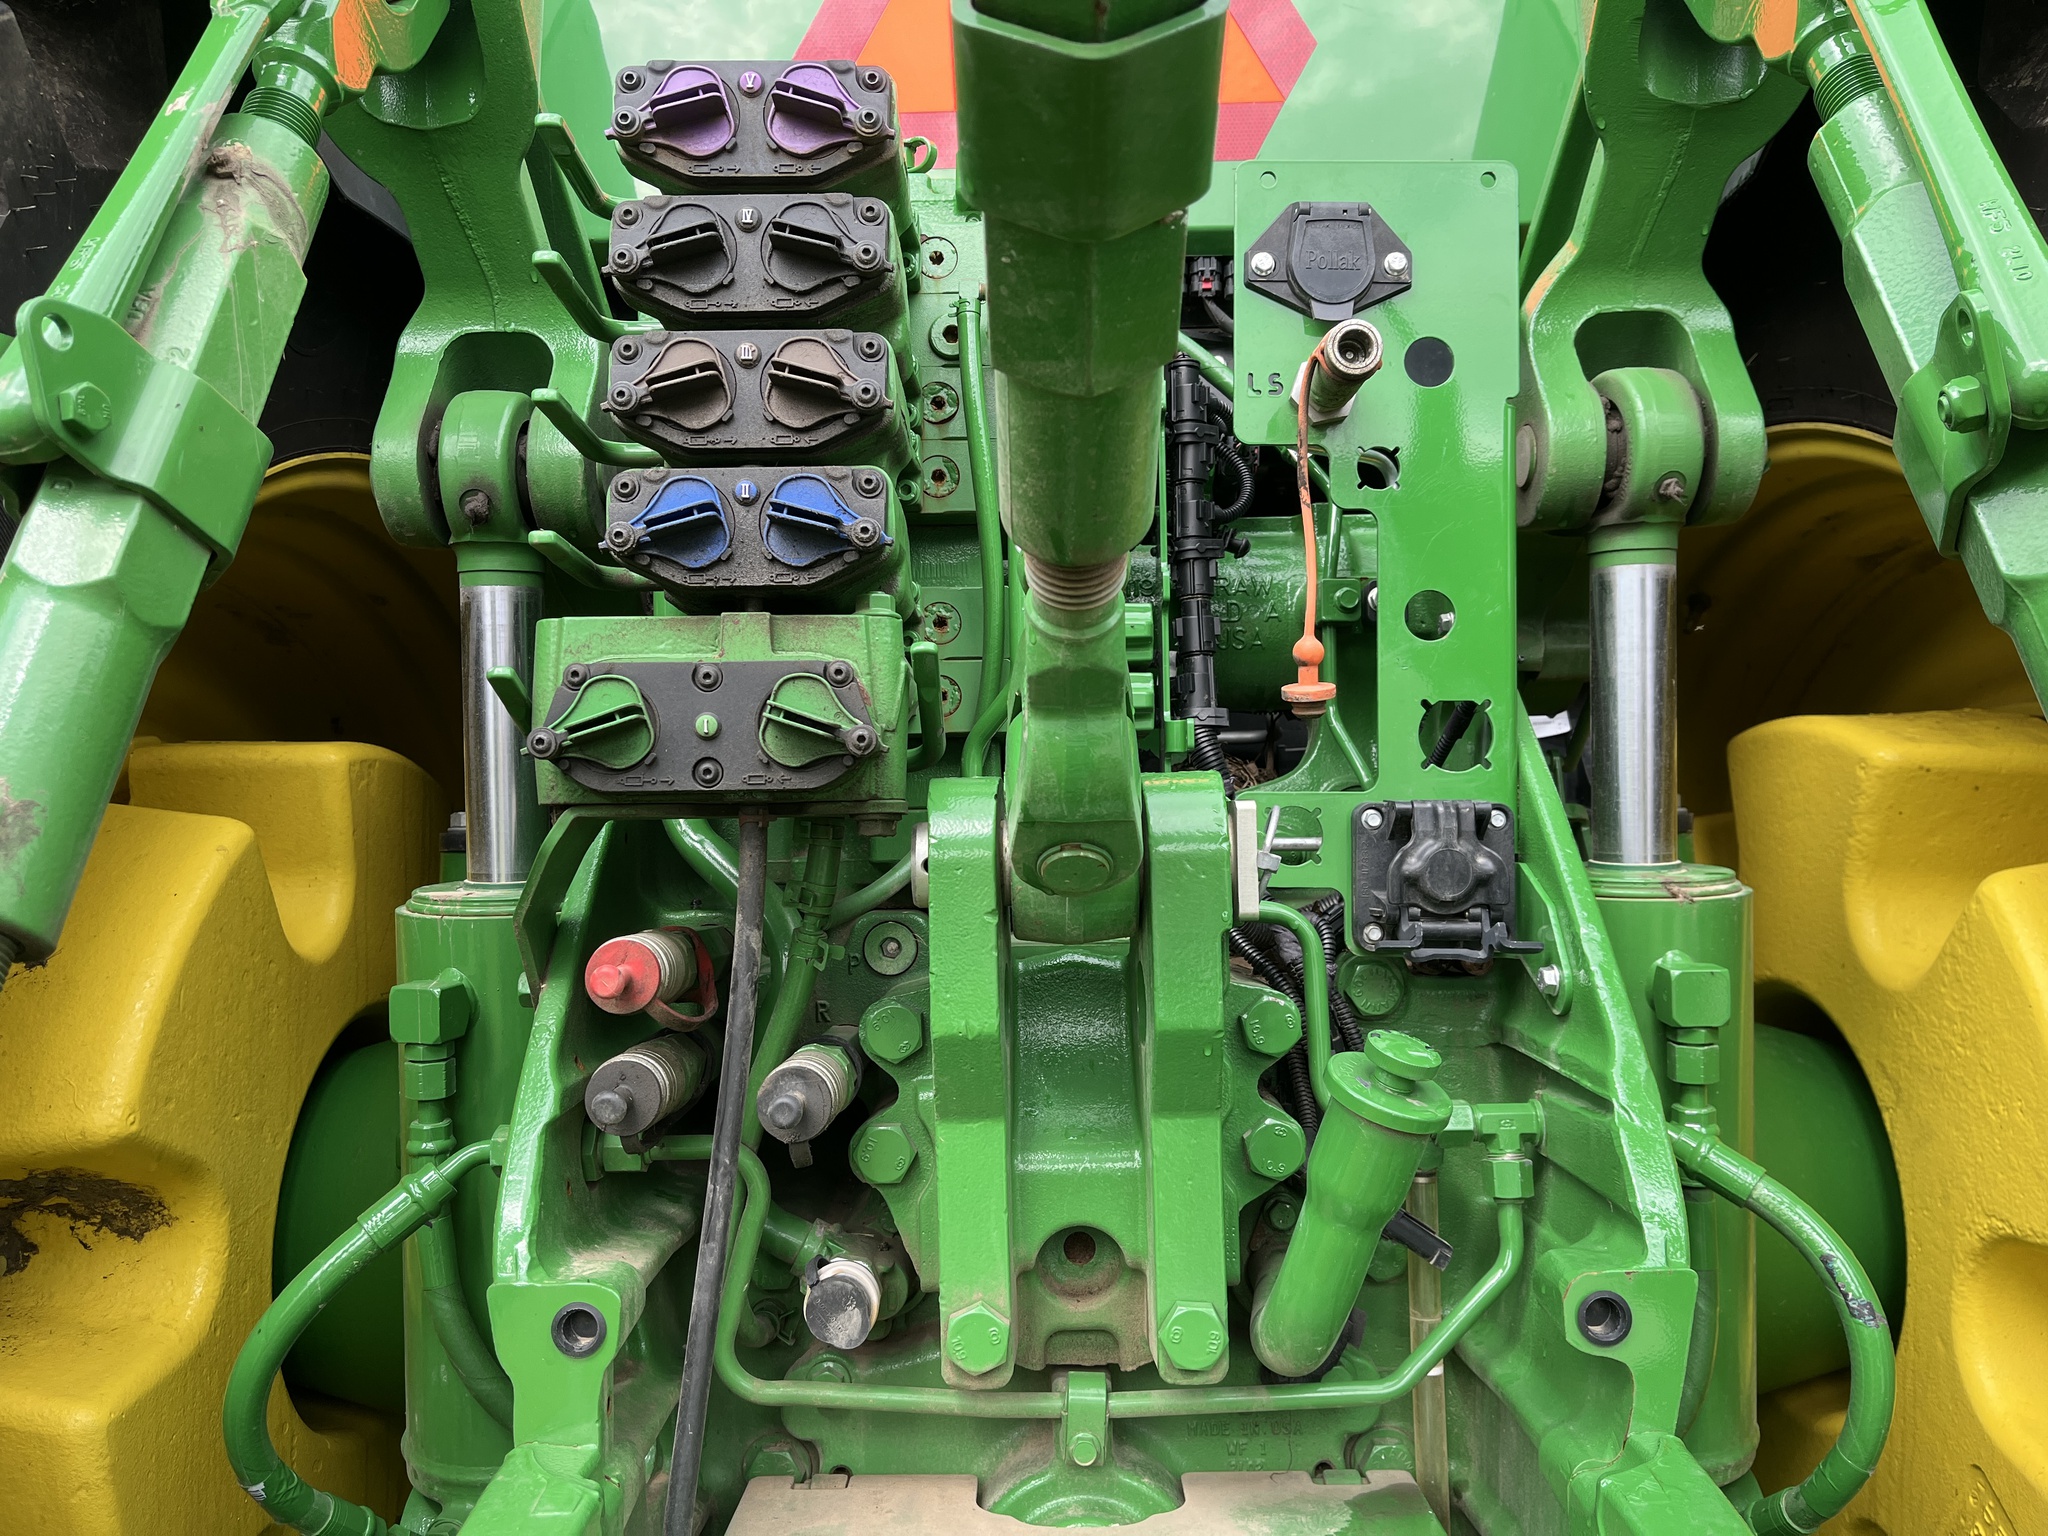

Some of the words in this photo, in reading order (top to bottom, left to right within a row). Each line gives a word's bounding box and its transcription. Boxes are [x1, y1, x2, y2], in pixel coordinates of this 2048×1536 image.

[745, 73, 756, 88] V
[741, 208, 754, 224] IV
[1305, 250, 1361, 271] Pollak
[740, 345, 753, 361] III
[741, 483, 750, 499] II
[848, 952, 861, 976] P
[815, 1000, 832, 1023] R
[872, 1010, 896, 1032] 10.9
[1250, 1019, 1265, 1045] 10.9
[861, 1137, 879, 1163] 10.9
[1261, 1157, 1286, 1174] 10.9
[1186, 1421, 1231, 1437] MADE
[1270, 1419, 1303, 1437] USA
[1226, 1440, 1248, 1457] WF
